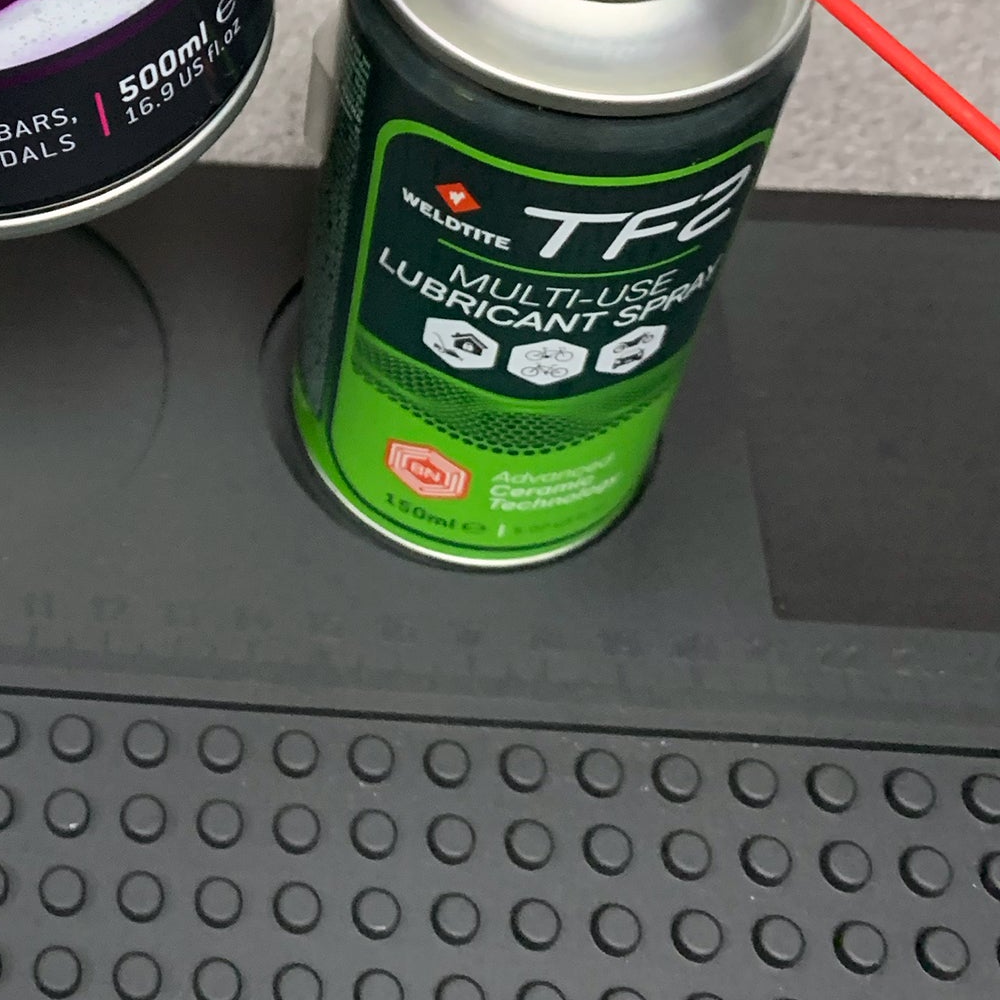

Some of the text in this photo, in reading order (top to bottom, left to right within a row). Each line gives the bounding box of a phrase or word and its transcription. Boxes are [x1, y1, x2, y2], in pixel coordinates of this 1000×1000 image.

[117, 21, 208, 103] 500ml
[124, 84, 175, 126] 16.9
[179, 61, 204, 88] US
[401, 187, 511, 251] WELDTITE
[523, 164, 752, 261] TF2
[379, 247, 610, 333] LUBRICANT
[450, 264, 680, 309] MULTI-USE
